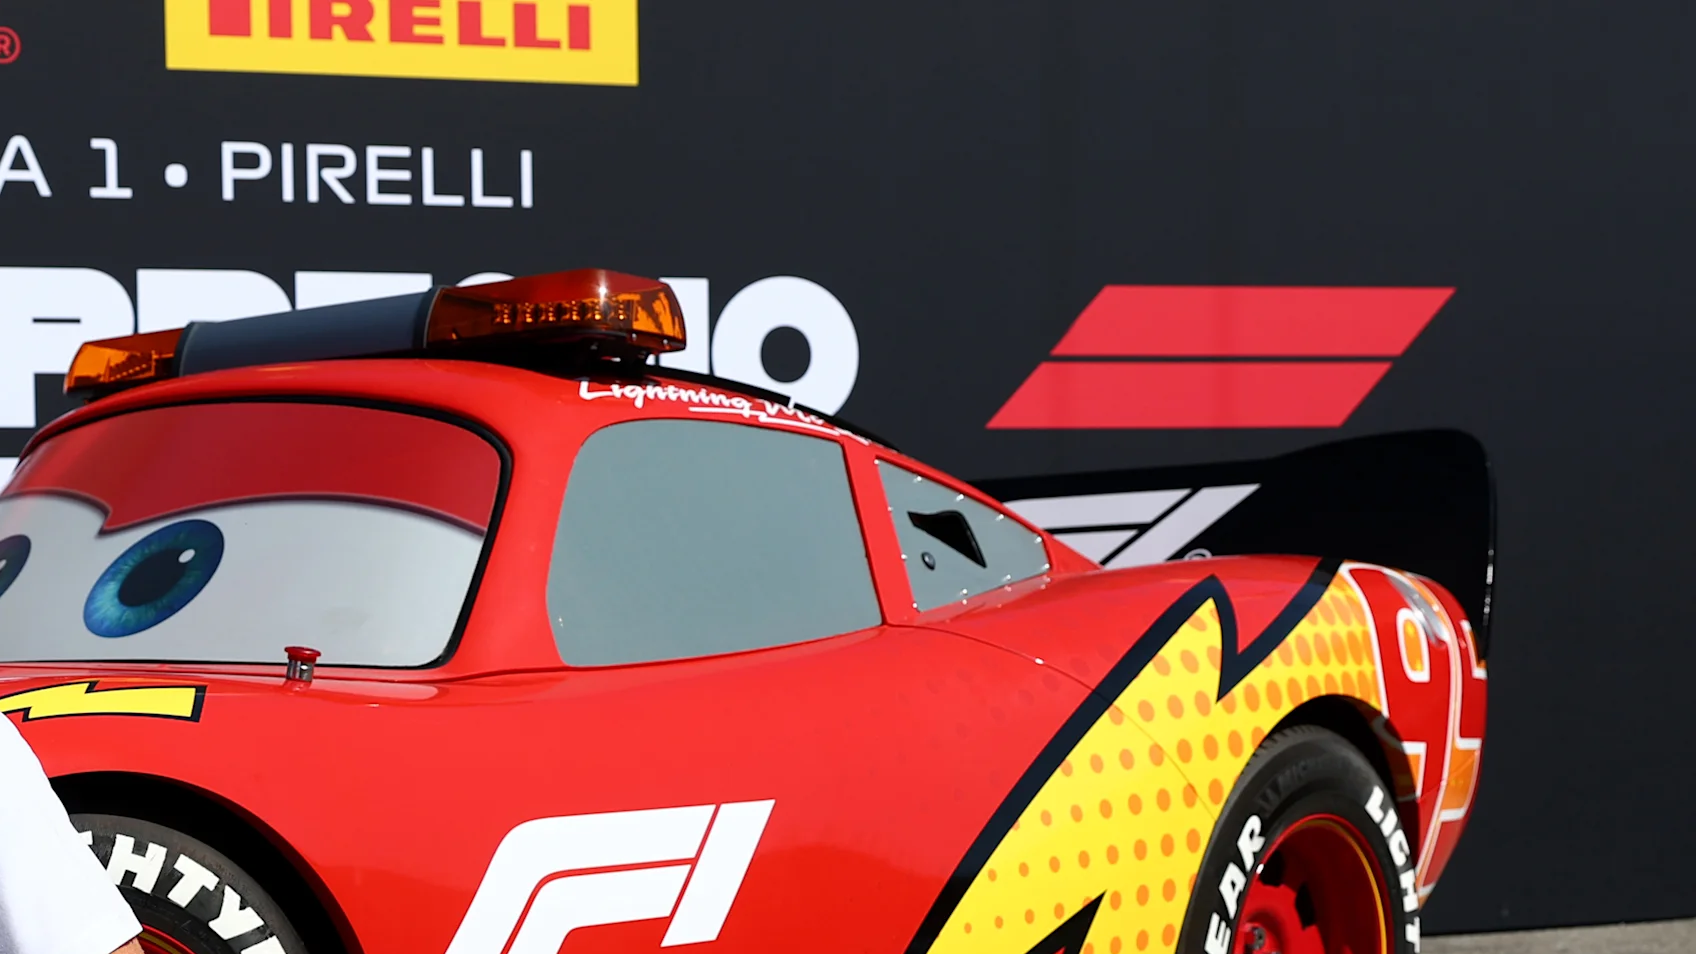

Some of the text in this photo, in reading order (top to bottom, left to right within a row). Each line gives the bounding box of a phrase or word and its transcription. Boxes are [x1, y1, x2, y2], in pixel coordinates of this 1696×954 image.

[89, 137, 134, 199] 1
[220, 140, 533, 209] PIRELLI
[577, 379, 753, 419] Lightning
